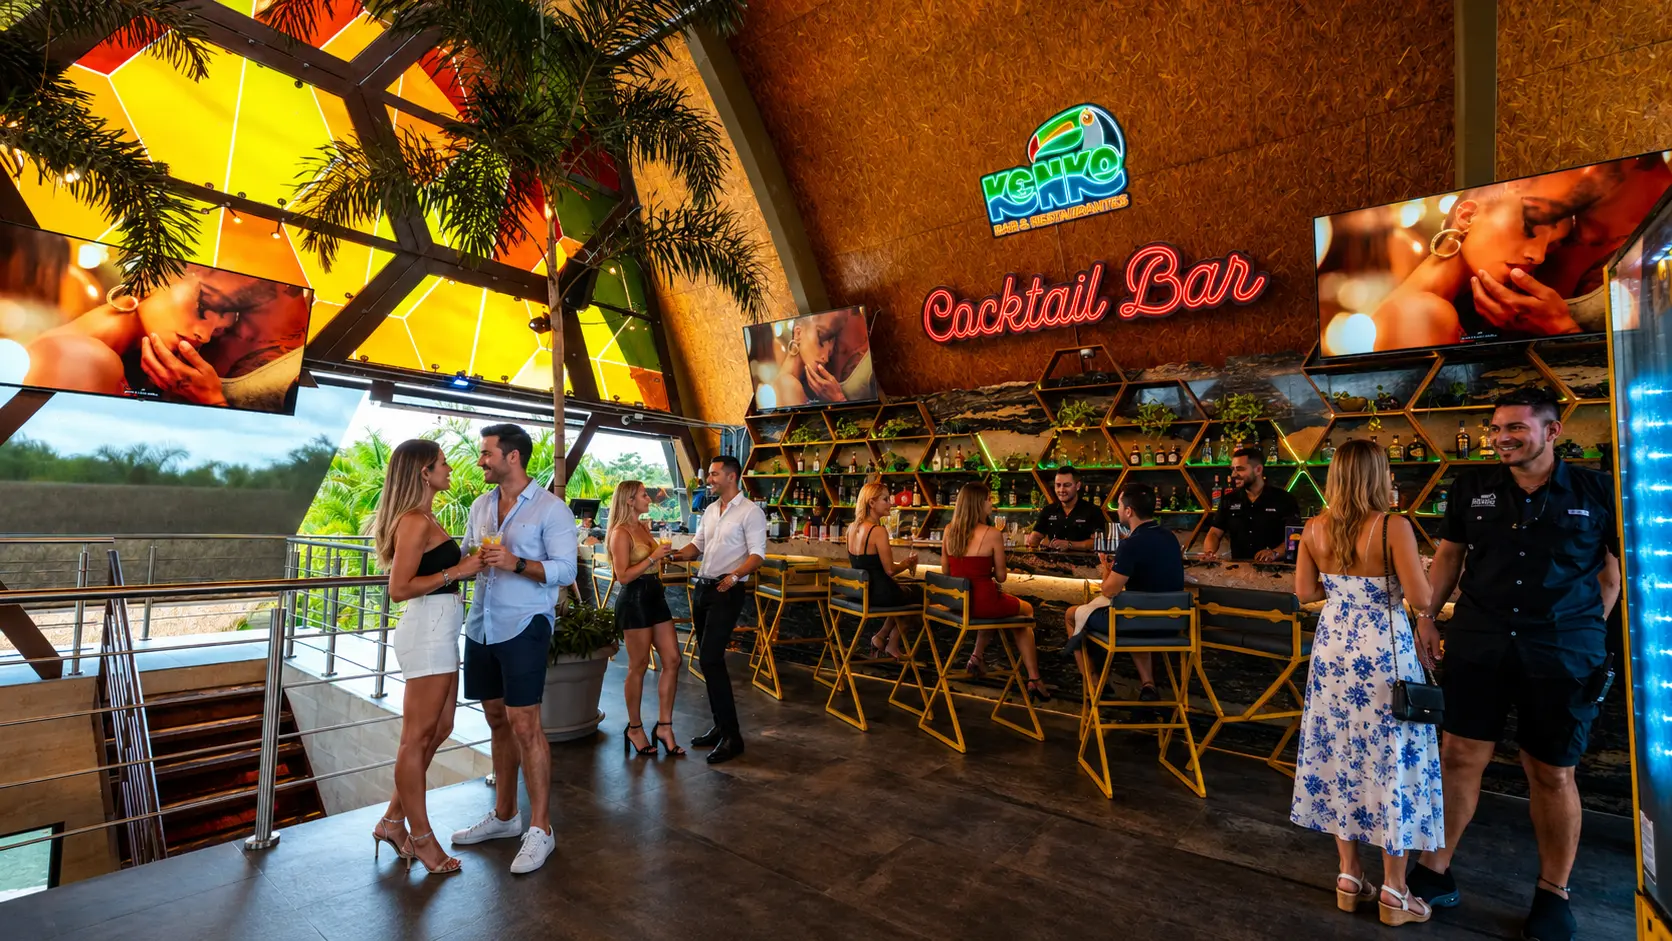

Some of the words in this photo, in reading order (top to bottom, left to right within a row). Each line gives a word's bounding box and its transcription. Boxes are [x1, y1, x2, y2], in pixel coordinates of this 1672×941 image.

[982, 145, 1127, 222] KENKO
[994, 220, 1019, 236] BAR
[1020, 218, 1030, 230] &
[924, 264, 1107, 342] Cocktail
[1118, 244, 1266, 318] Bar
